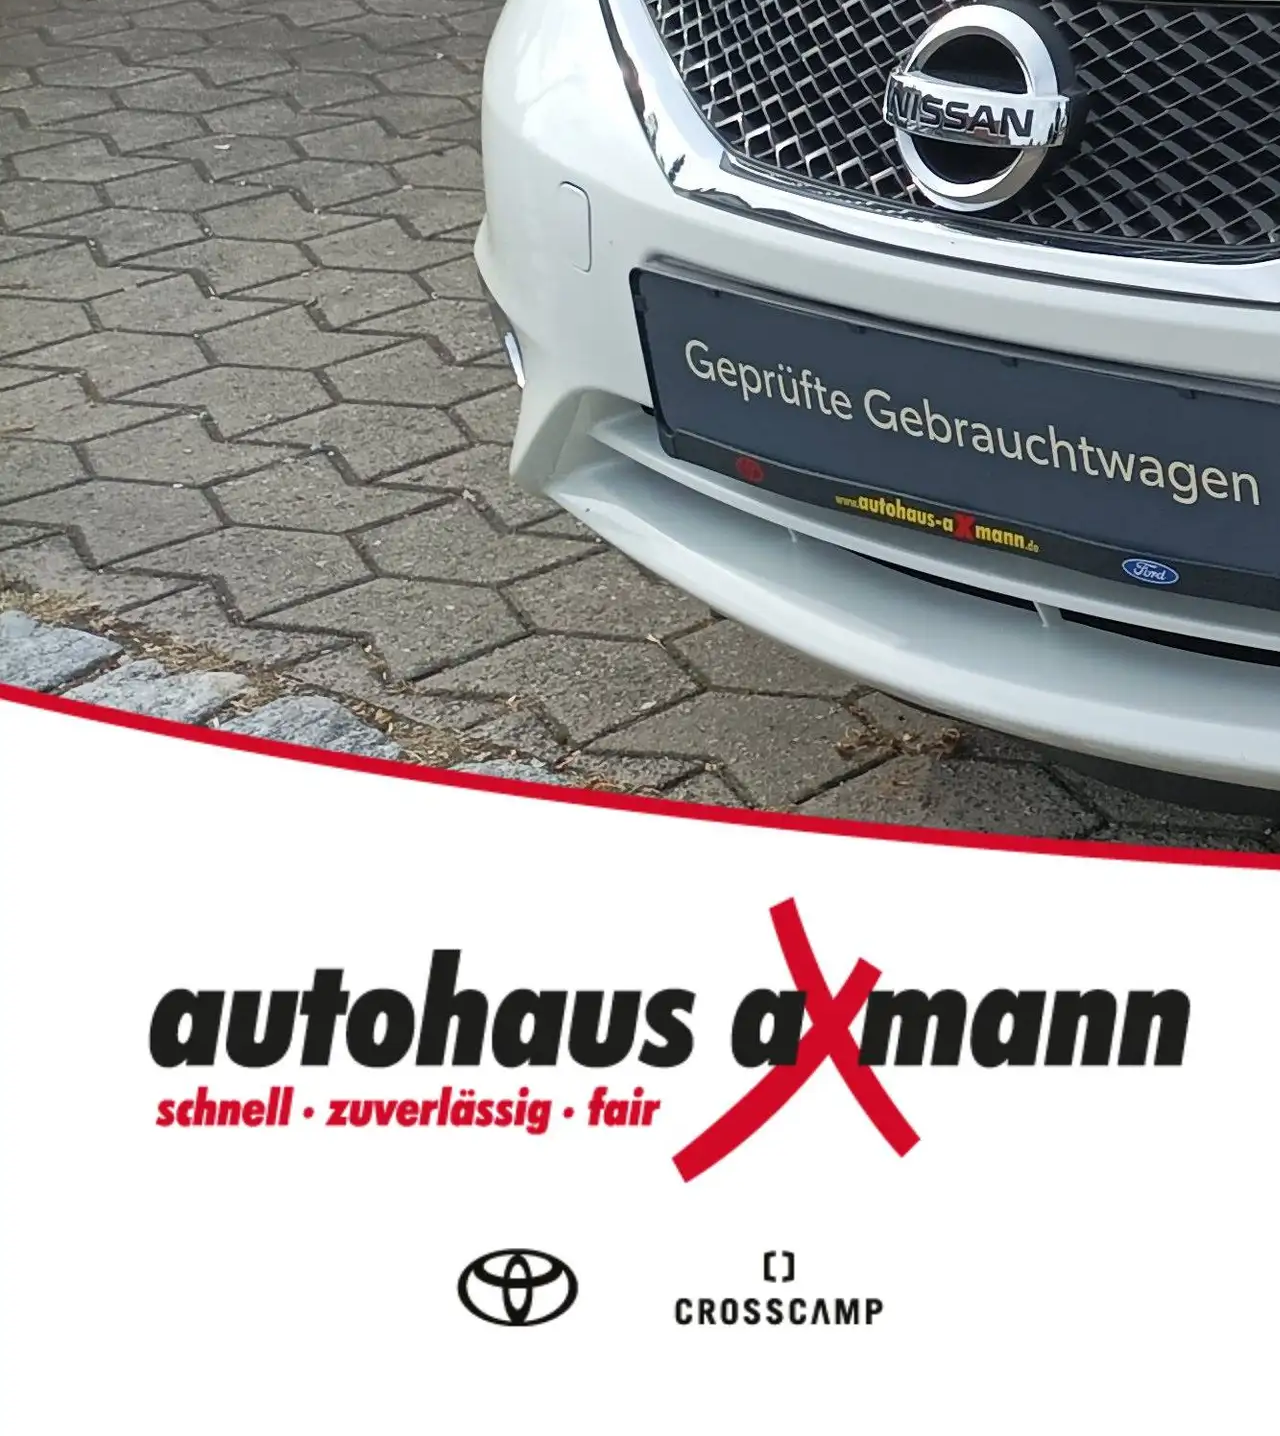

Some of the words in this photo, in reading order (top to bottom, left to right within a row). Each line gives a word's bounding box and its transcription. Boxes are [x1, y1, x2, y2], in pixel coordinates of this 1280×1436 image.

[885, 78, 1034, 138] NISSAN
[684, 339, 854, 420] Geprüfte
[863, 389, 1261, 506] Gebrauchtwagen
